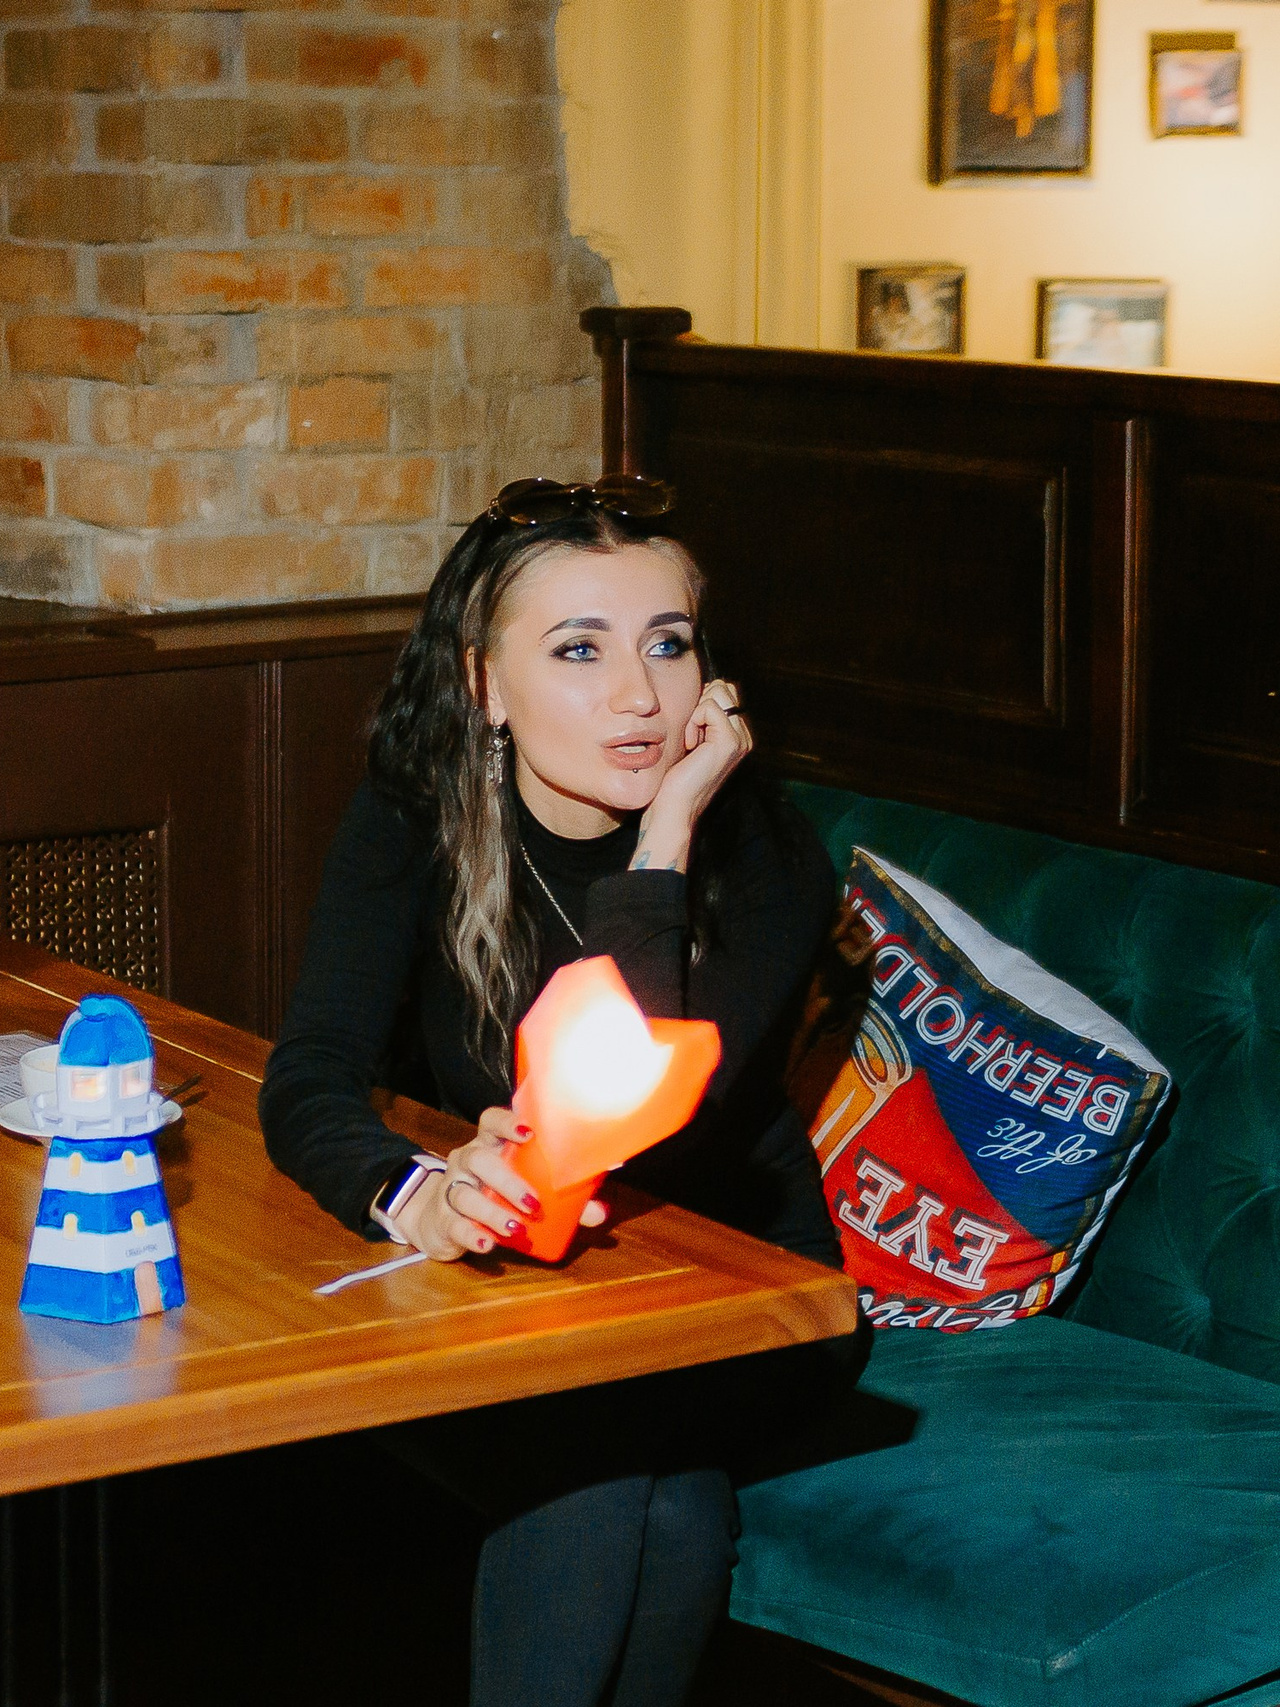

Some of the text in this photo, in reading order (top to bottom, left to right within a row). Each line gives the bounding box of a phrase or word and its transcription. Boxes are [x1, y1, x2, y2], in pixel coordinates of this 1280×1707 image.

[844, 884, 1132, 1137] BEERHOLD
[977, 1117, 1098, 1174] of the
[838, 1157, 1009, 1291] EYE
